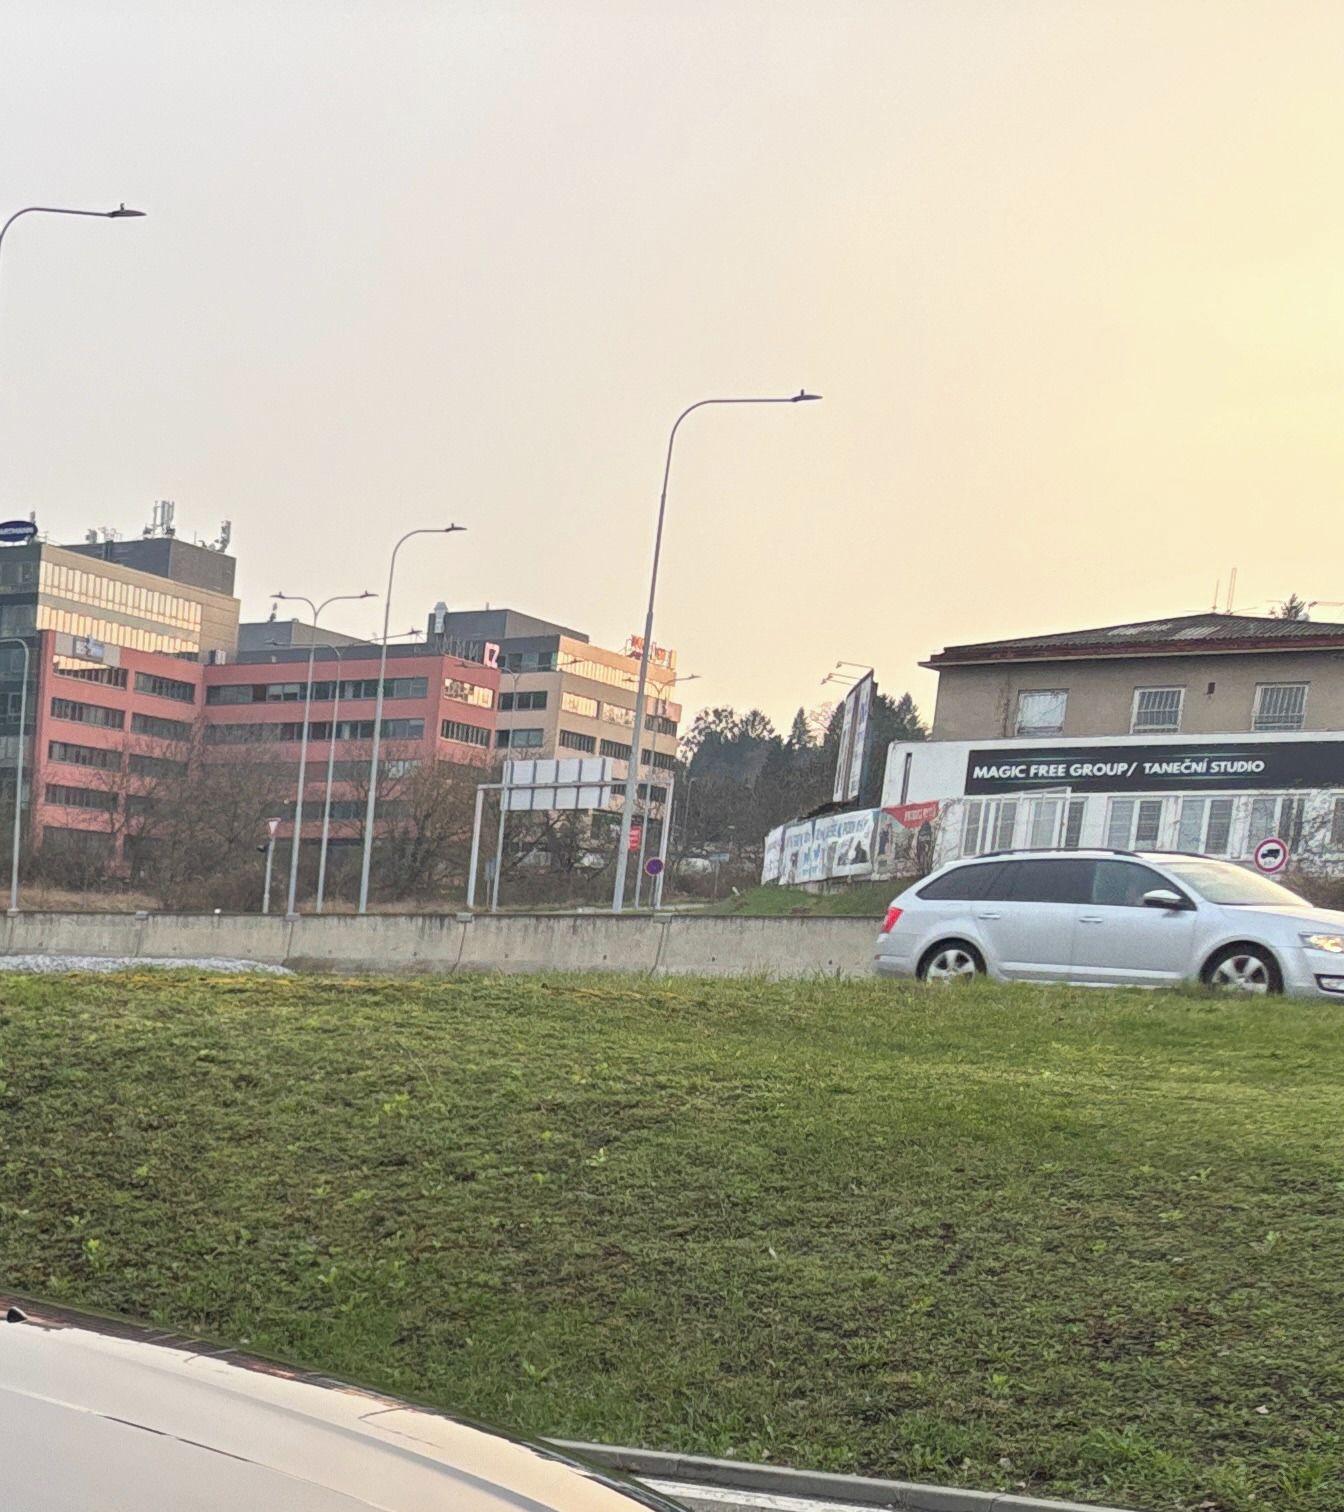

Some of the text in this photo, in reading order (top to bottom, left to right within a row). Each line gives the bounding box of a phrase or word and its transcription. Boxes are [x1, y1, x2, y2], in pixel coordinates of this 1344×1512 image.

[972, 764, 1027, 780] MAGIC
[1029, 763, 1068, 778] FREE
[1143, 757, 1209, 775] TANEČNÍ
[1209, 759, 1265, 773] STUDIO
